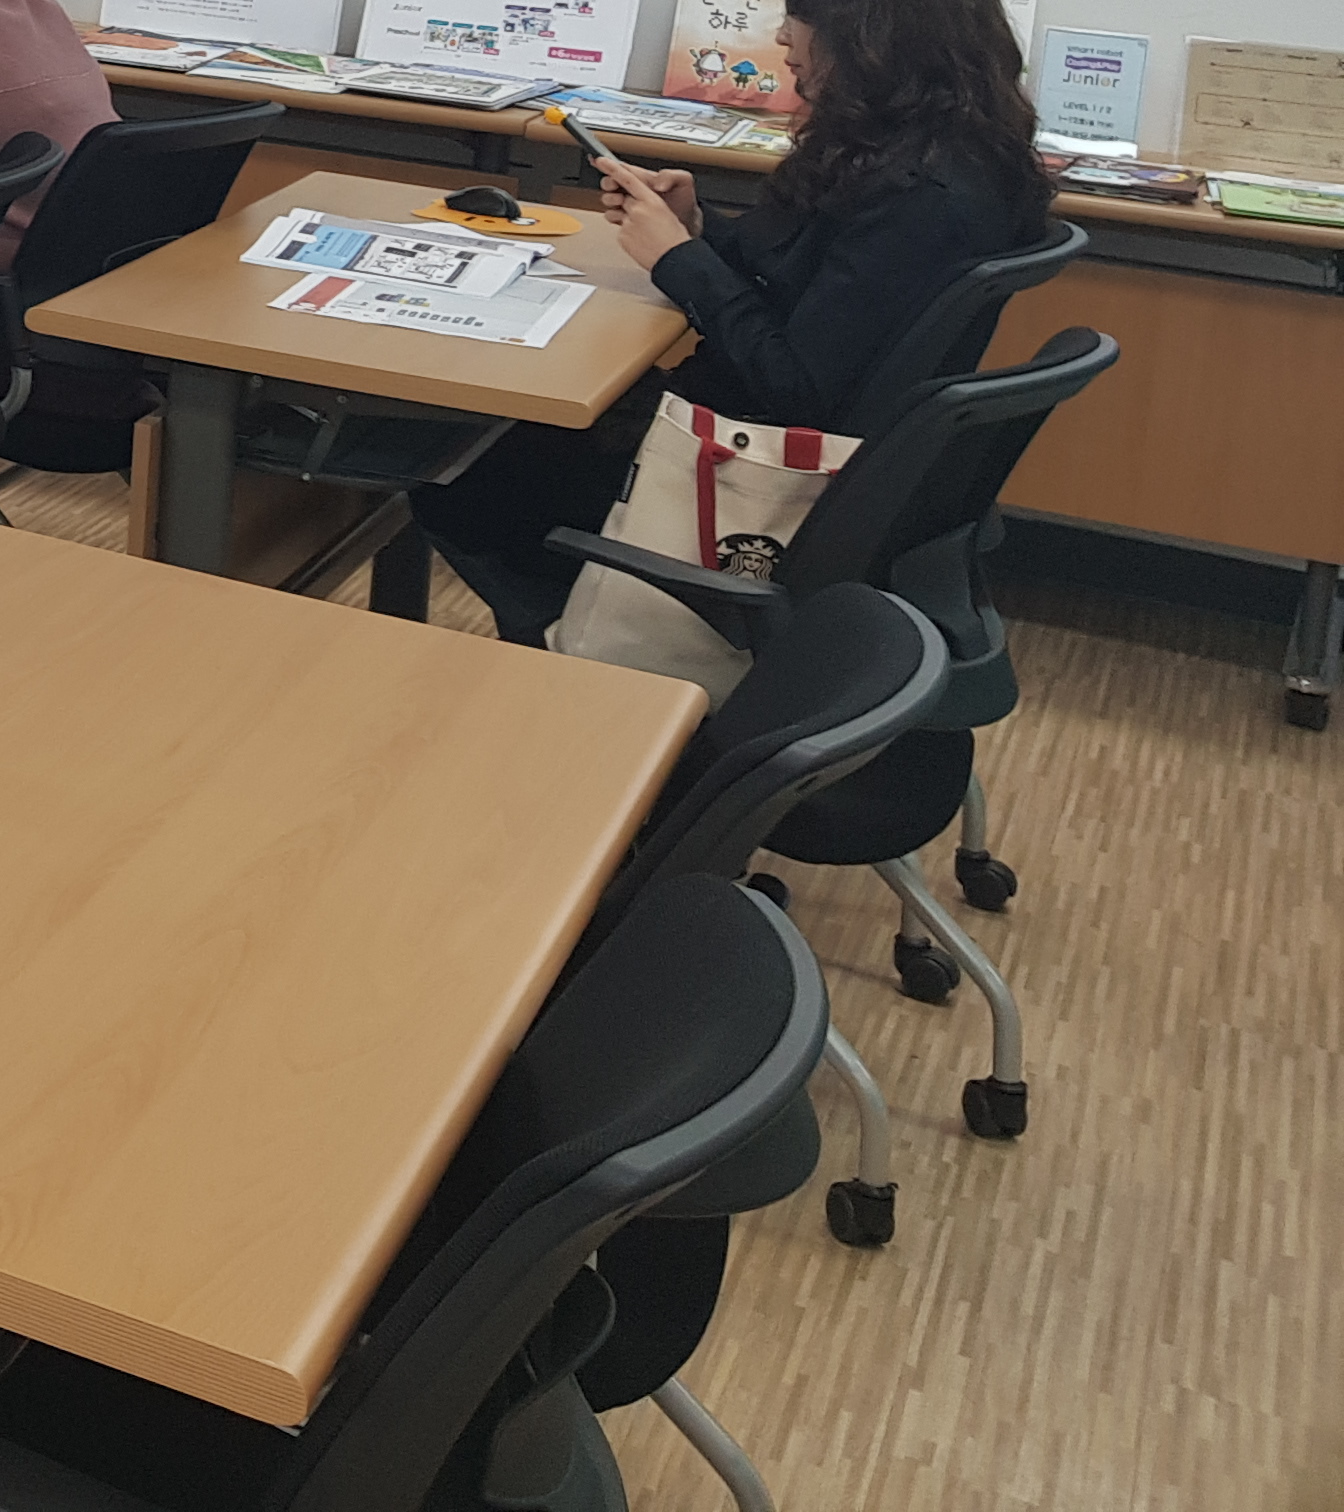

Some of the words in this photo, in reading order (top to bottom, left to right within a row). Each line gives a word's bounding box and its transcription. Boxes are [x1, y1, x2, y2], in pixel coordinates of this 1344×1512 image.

[707, 8, 750, 32] 하루
[1062, 70, 1121, 88] Junior
[1063, 101, 1089, 112] LEVEL
